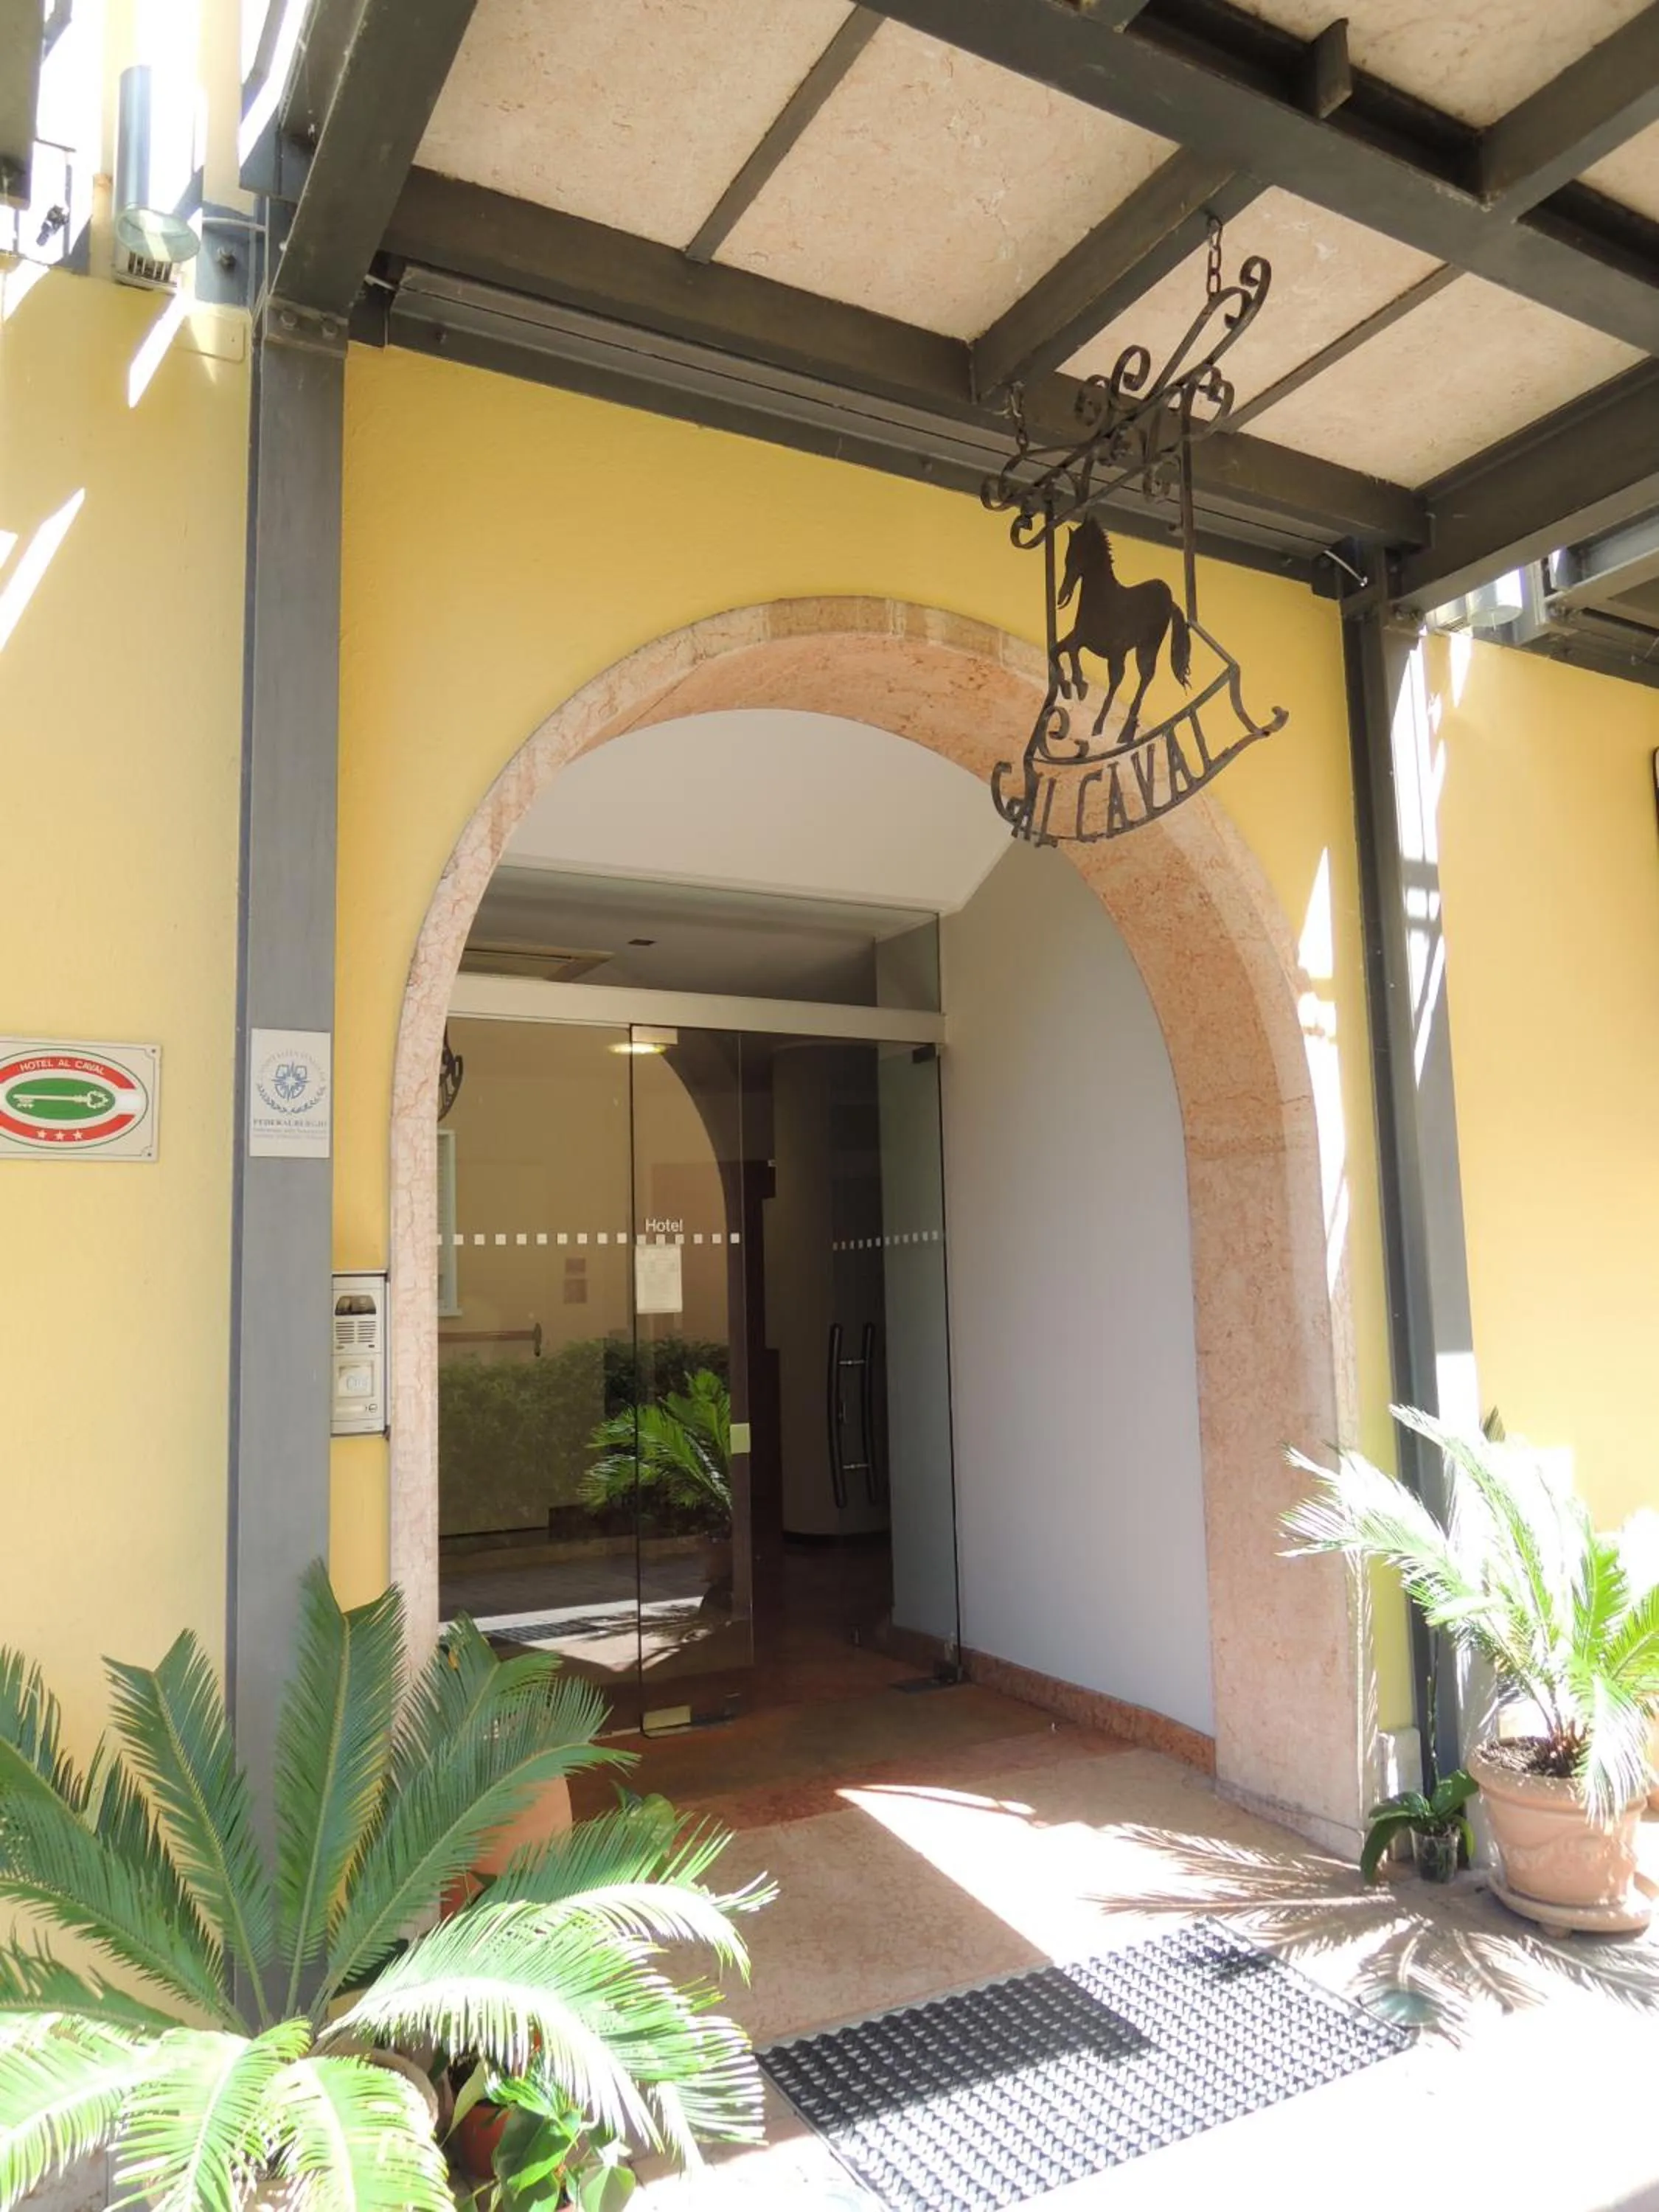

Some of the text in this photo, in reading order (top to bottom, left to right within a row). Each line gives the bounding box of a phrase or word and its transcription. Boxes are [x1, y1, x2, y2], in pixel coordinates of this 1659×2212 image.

[1075, 706, 1231, 844] CAVAL
[19, 1059, 106, 1076] HOTEL AL CAVAL
[645, 1218, 683, 1232] Hotel
